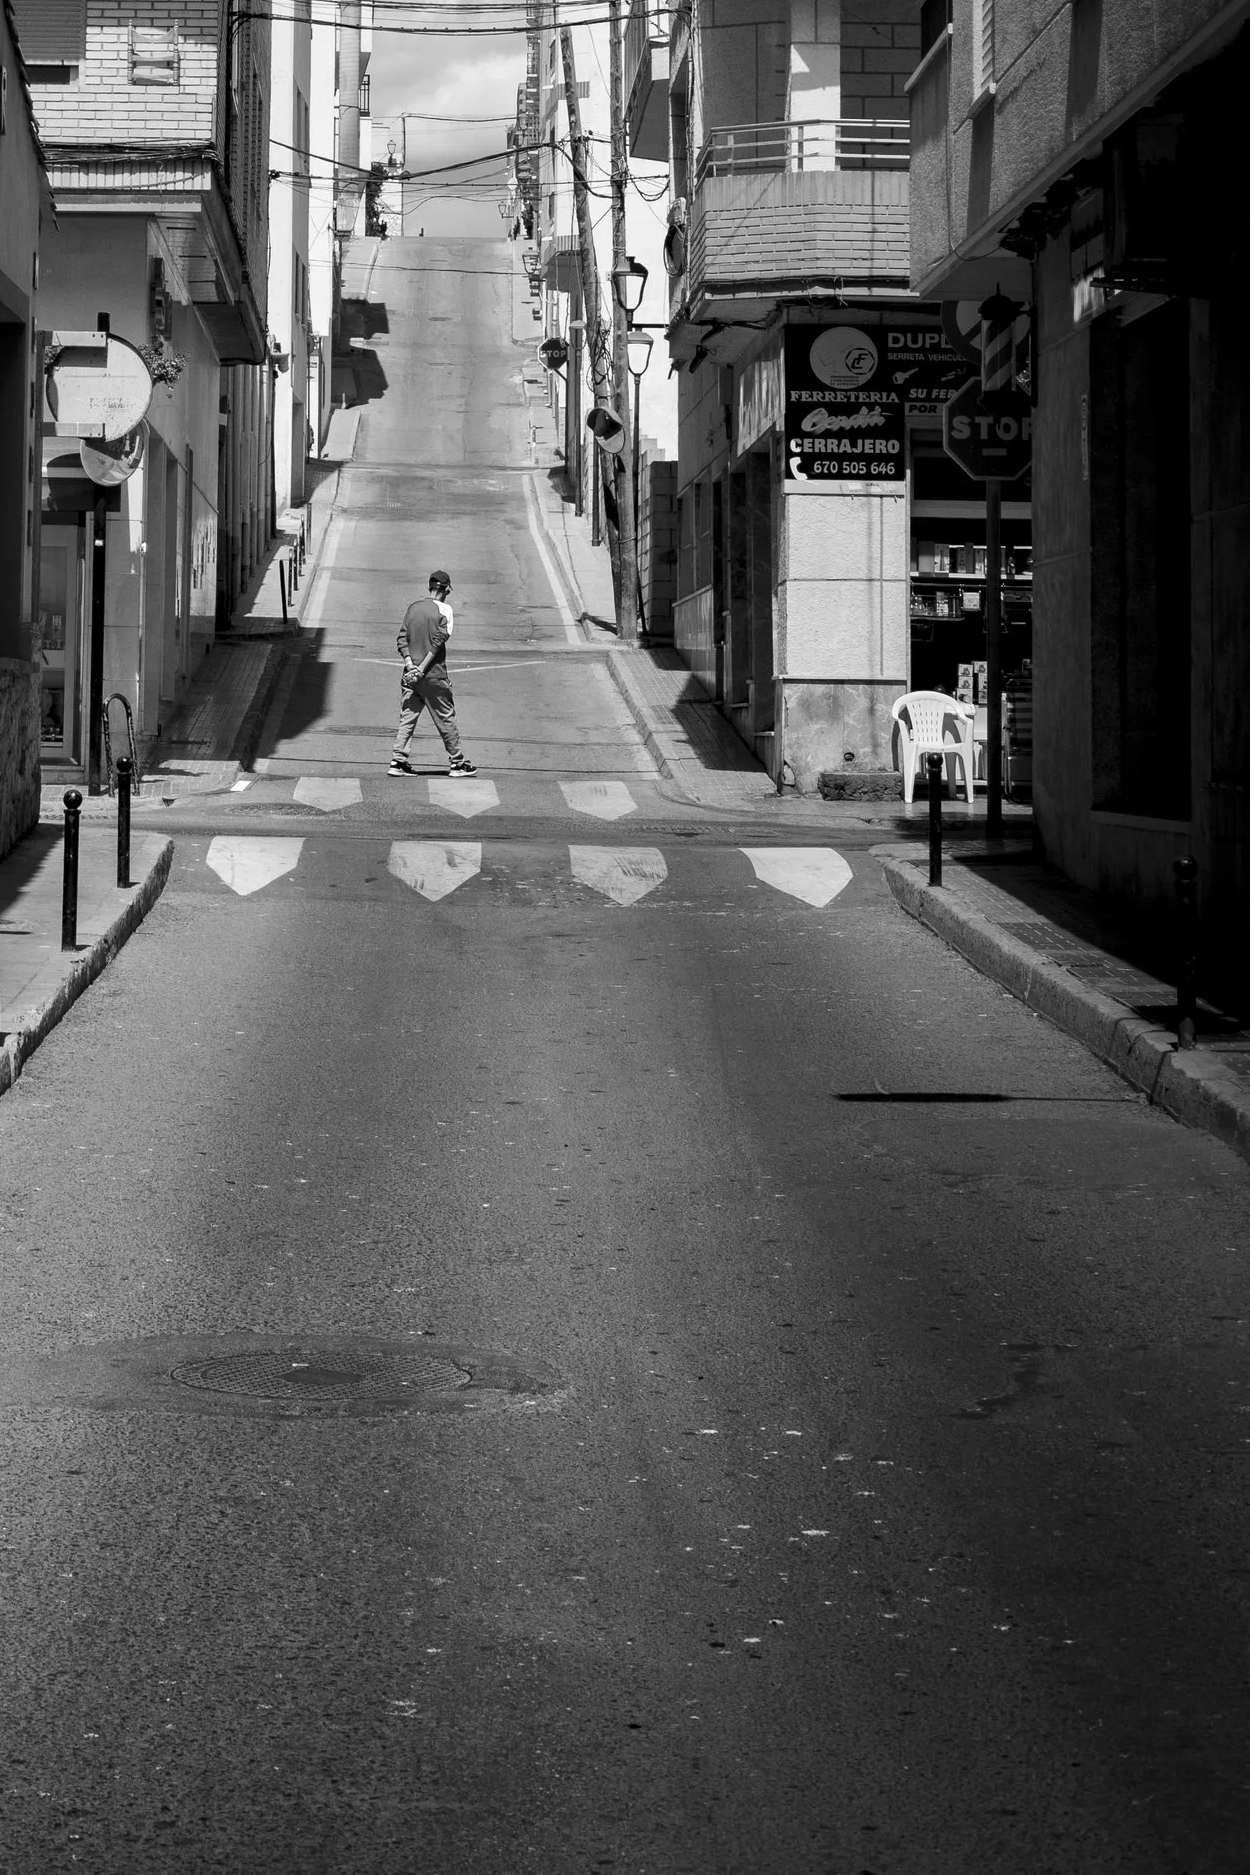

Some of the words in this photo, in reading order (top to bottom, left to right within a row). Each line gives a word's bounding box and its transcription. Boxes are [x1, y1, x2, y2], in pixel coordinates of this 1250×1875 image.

[540, 350, 567, 358] STOP
[887, 353, 925, 361] SERRETA
[789, 390, 900, 404] FERRETERIA
[908, 388, 928, 399] SU
[909, 404, 938, 414] POR
[789, 438, 900, 455] CERRAJERO
[813, 461, 839, 474] 670
[842, 461, 867, 475] 505
[870, 462, 896, 475] 646
